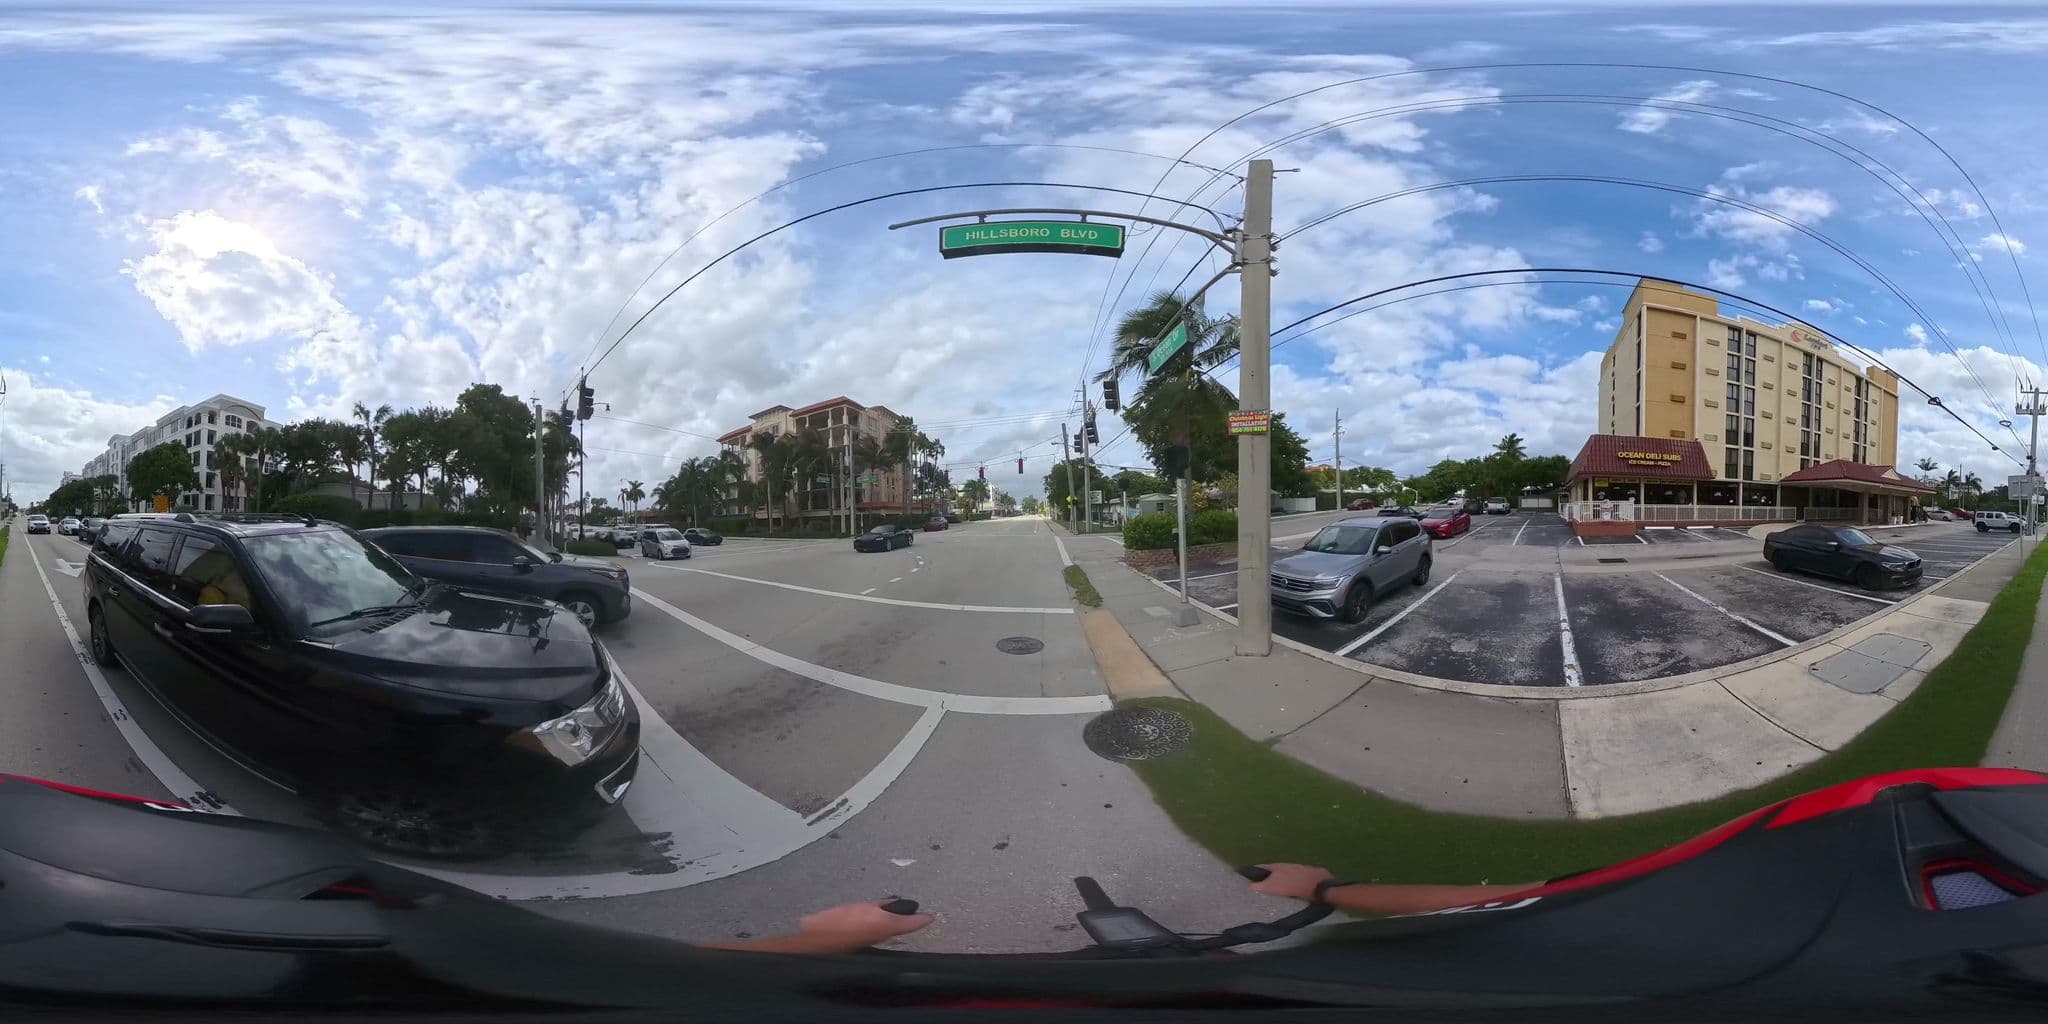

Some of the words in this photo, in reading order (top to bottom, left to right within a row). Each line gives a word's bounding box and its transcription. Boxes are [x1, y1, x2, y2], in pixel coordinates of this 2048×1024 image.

[965, 228, 1050, 241] HILLSBORO
[1060, 228, 1098, 240] BLVD
[1618, 451, 1645, 459] OCEAN
